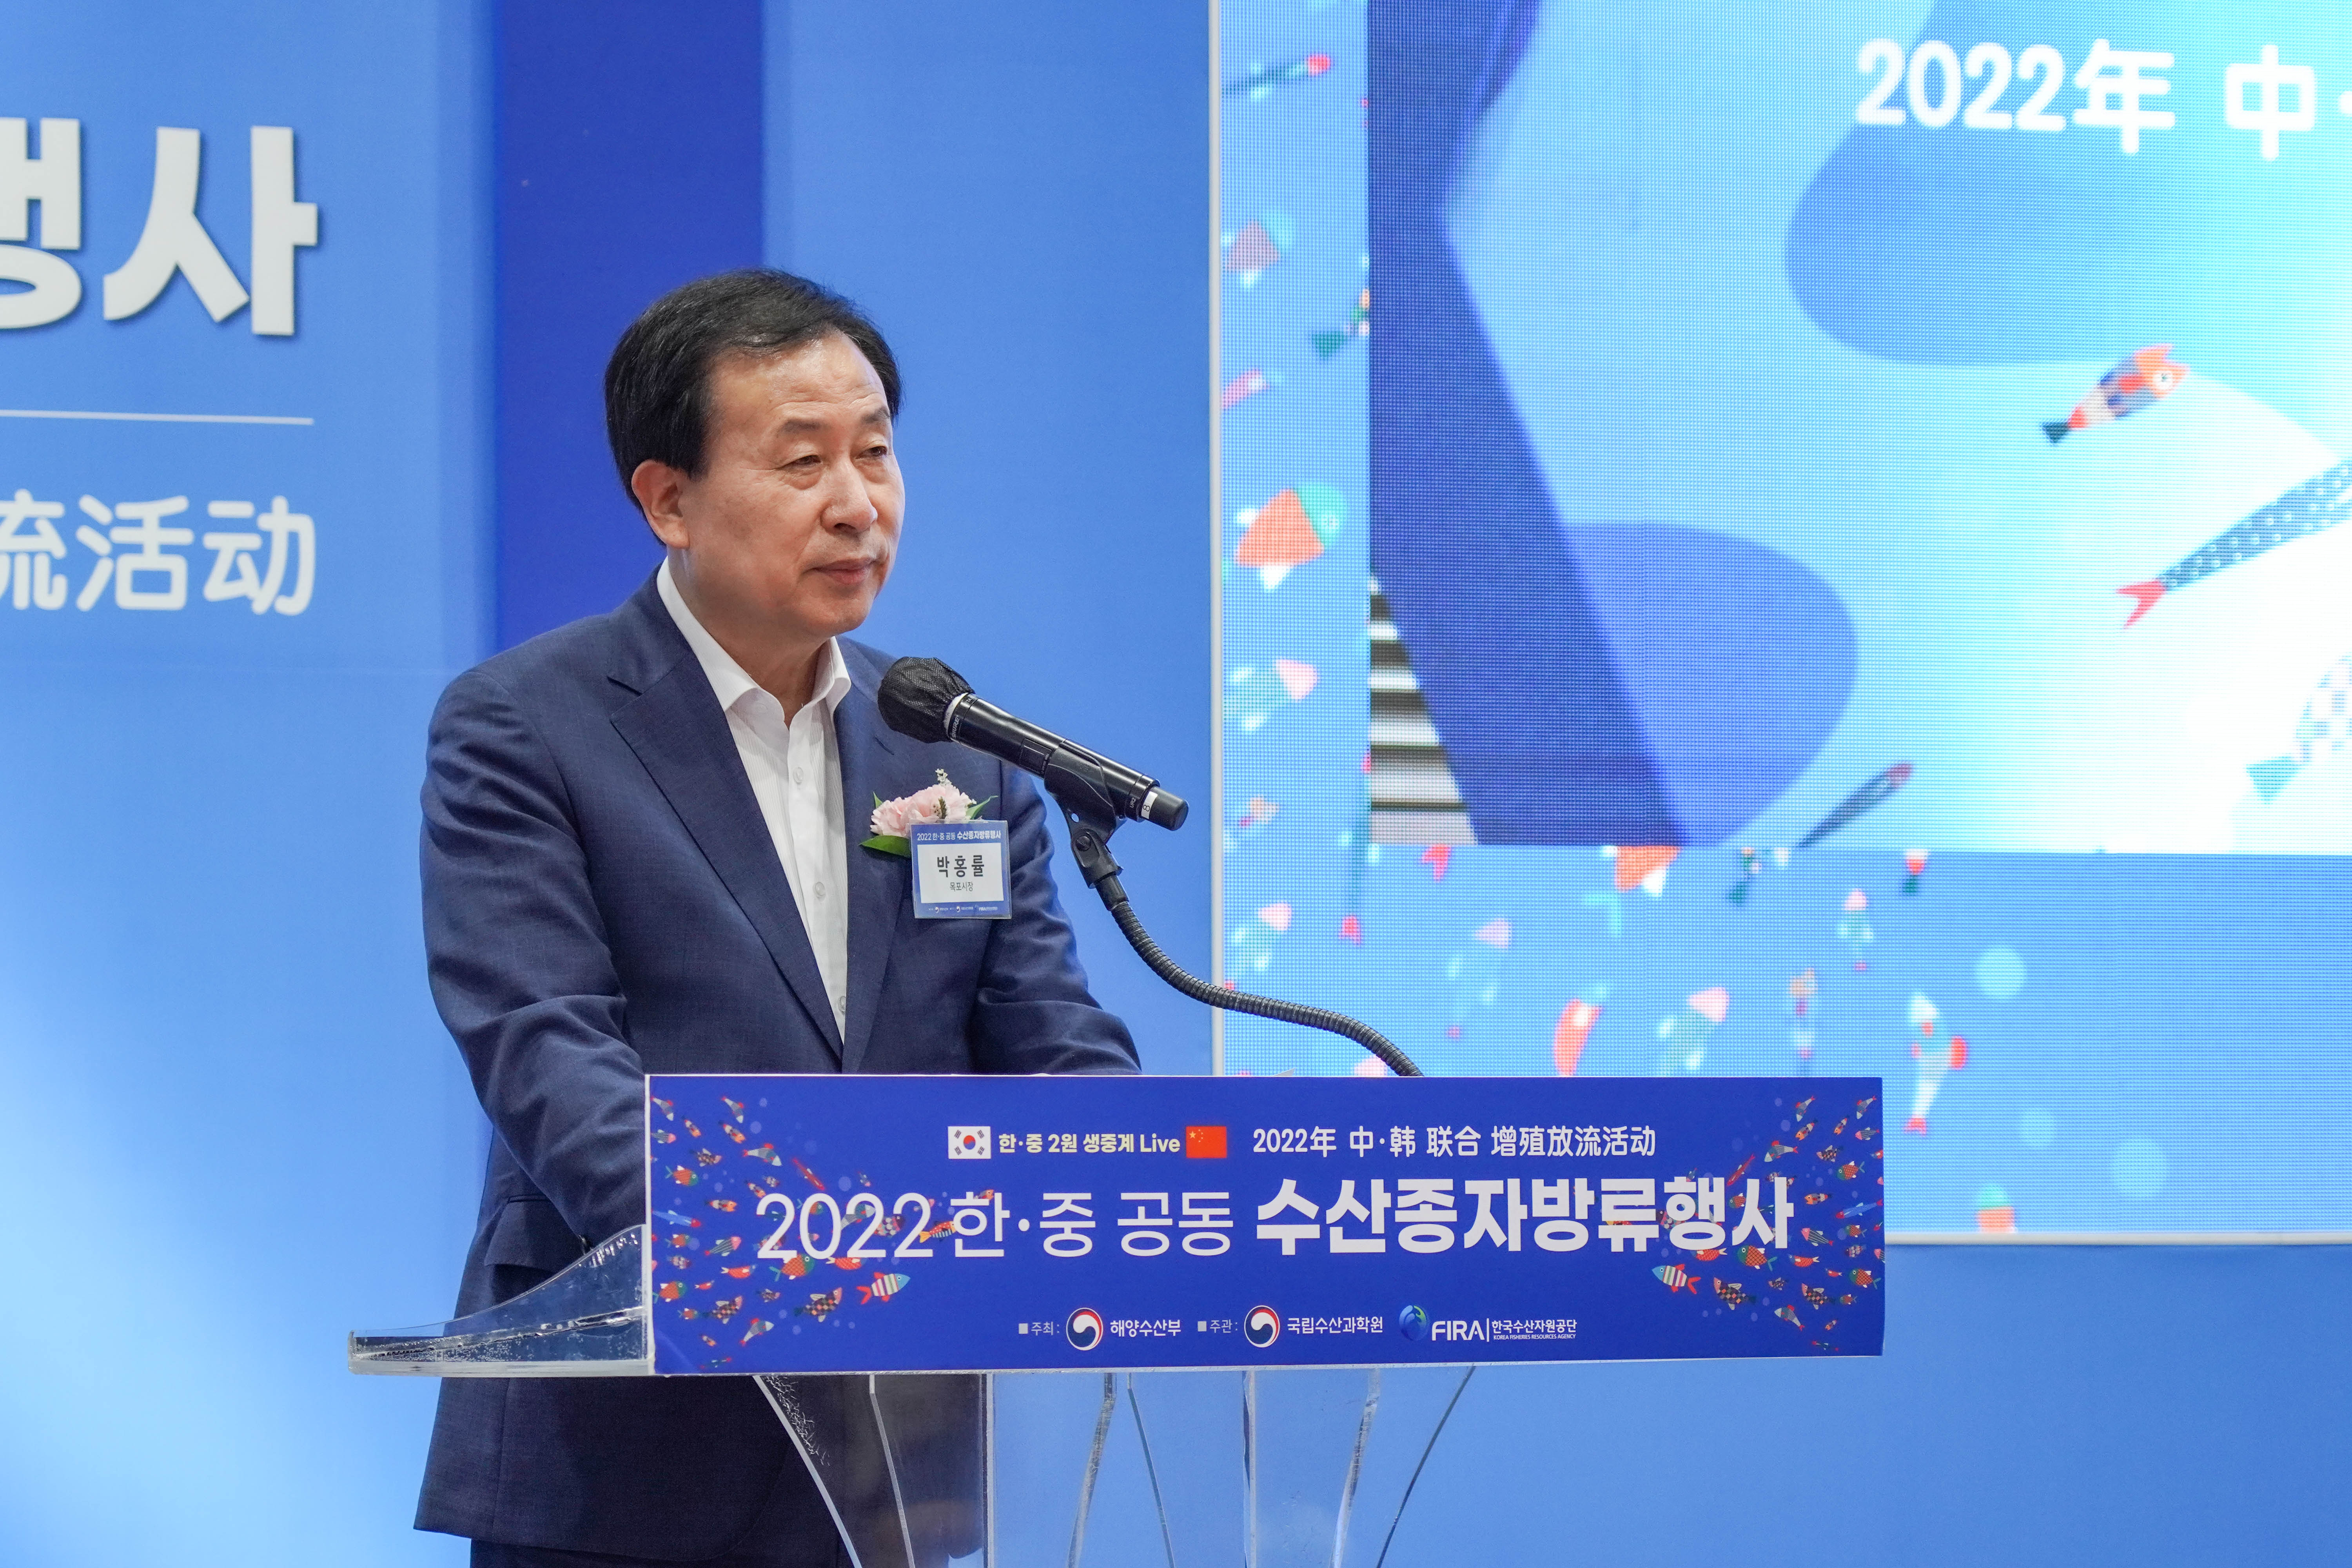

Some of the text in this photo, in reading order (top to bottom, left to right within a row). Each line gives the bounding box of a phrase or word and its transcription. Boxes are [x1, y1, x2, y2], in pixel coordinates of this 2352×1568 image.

[1856, 38, 2176, 154] 2022年
[950, 882, 973, 892] 목포시장
[999, 1133, 1180, 1153] 한·중 2원 생중계 Live
[1254, 1126, 1336, 1157] 2022年
[1426, 1126, 1481, 1157] 联合
[1491, 1125, 1655, 1156] 增殖放流活动
[1118, 1192, 1233, 1256] 공동
[1257, 1176, 1794, 1256] 수산종자방류행사
[1110, 1320, 1181, 1337] 해양수산부
[1288, 1317, 1383, 1334] 국립수산과학원
[1432, 1320, 1485, 1341] FIRA
[1492, 1319, 1577, 1333] 한국수산자원공단
